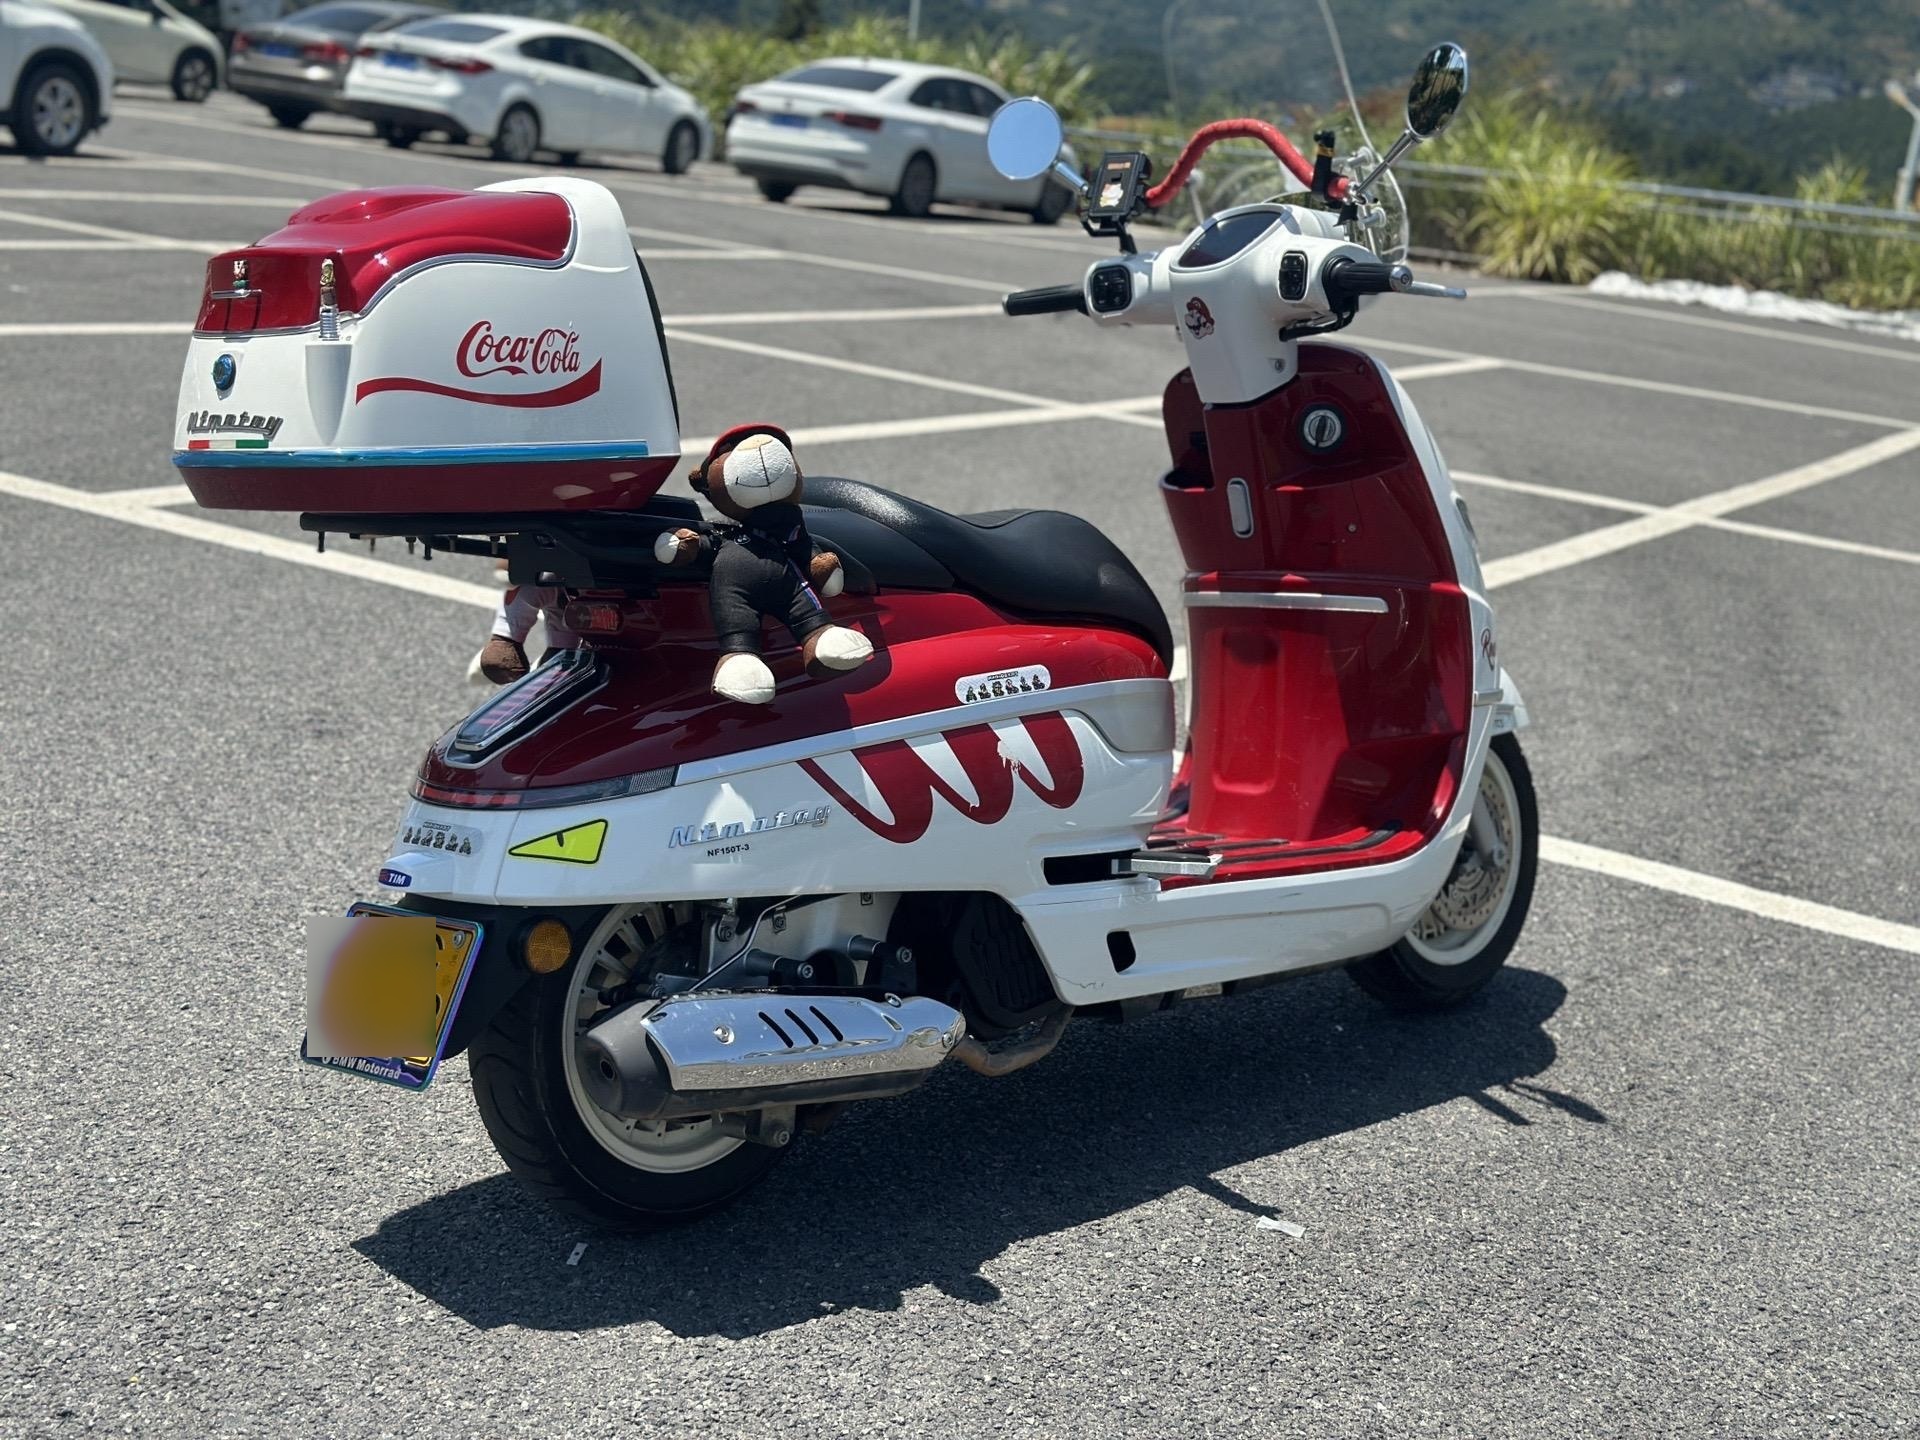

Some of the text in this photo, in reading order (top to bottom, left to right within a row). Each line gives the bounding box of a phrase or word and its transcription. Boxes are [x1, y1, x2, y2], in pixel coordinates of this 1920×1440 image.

[456, 320, 581, 378] Coca-Cola
[707, 843, 750, 857] NF150T-3
[388, 872, 406, 885] TIM
[332, 1056, 401, 1080] BMW Motorrad
